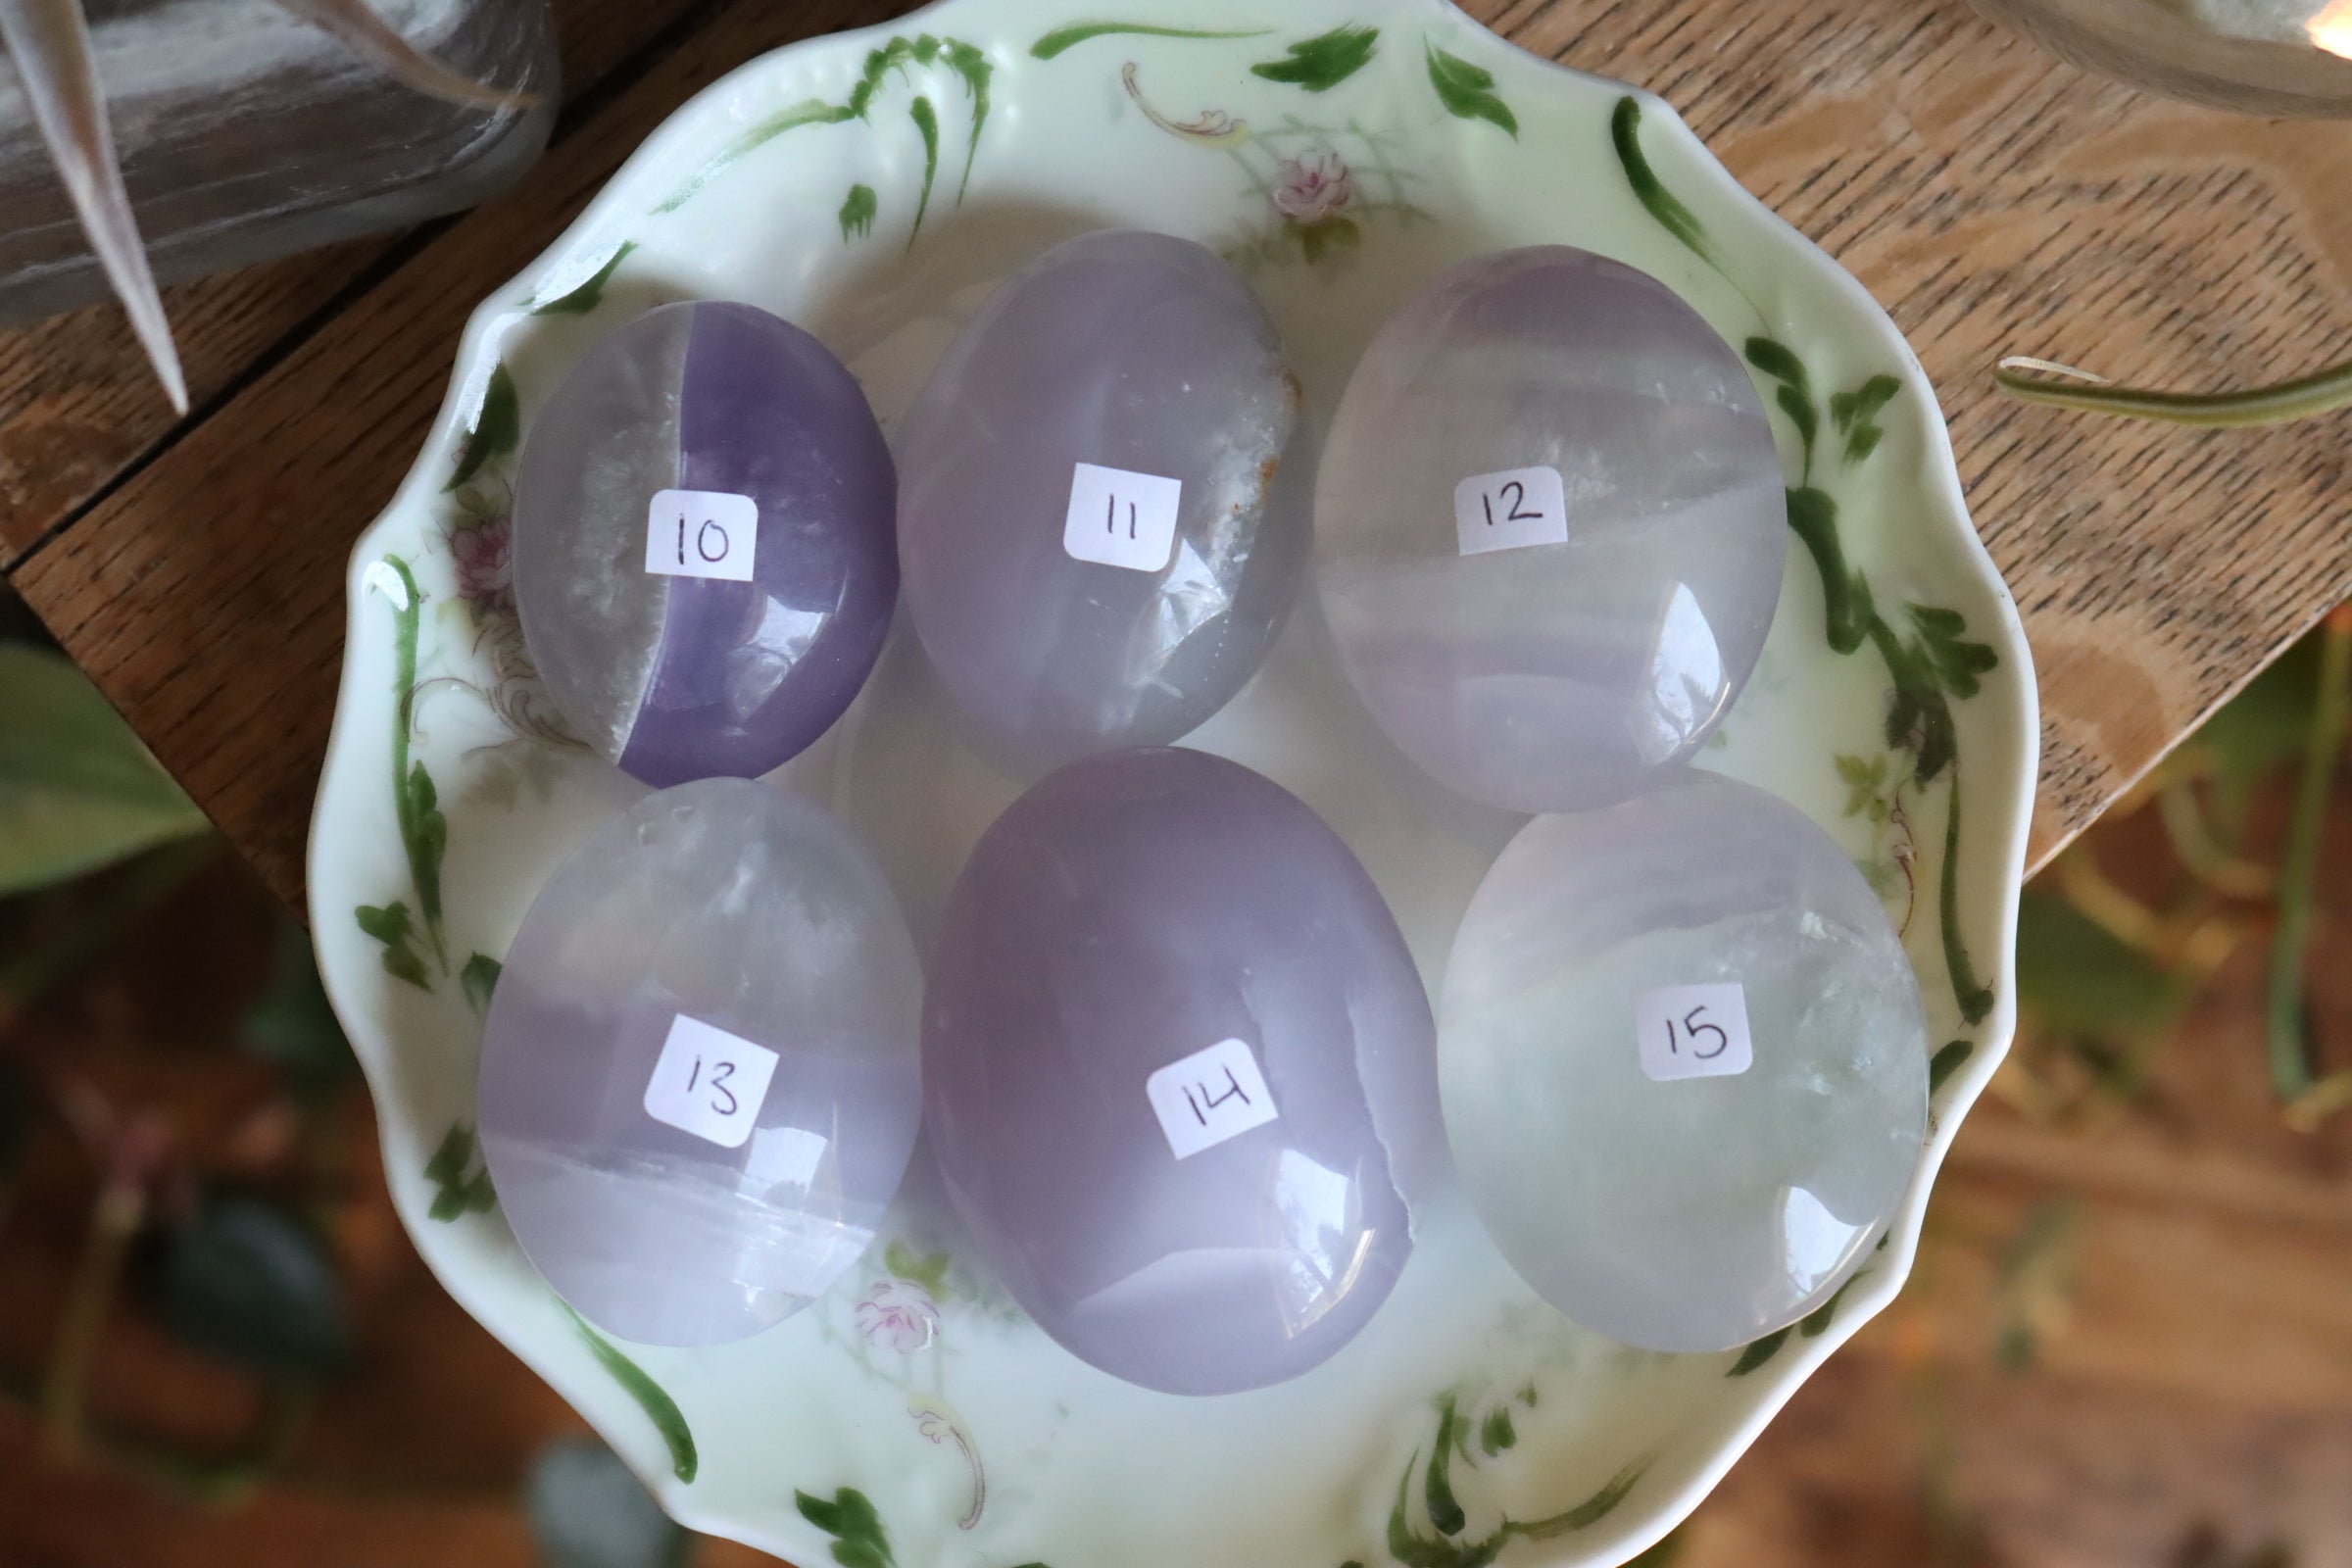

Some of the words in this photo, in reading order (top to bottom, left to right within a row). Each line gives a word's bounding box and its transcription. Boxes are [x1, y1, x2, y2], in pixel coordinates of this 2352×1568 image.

[1106, 493, 1137, 540] 11
[1482, 481, 1544, 526] 12
[676, 514, 729, 565] 10
[1665, 1005, 1729, 1060] 15
[686, 1057, 738, 1116] 13
[1182, 1062, 1250, 1126] 14
